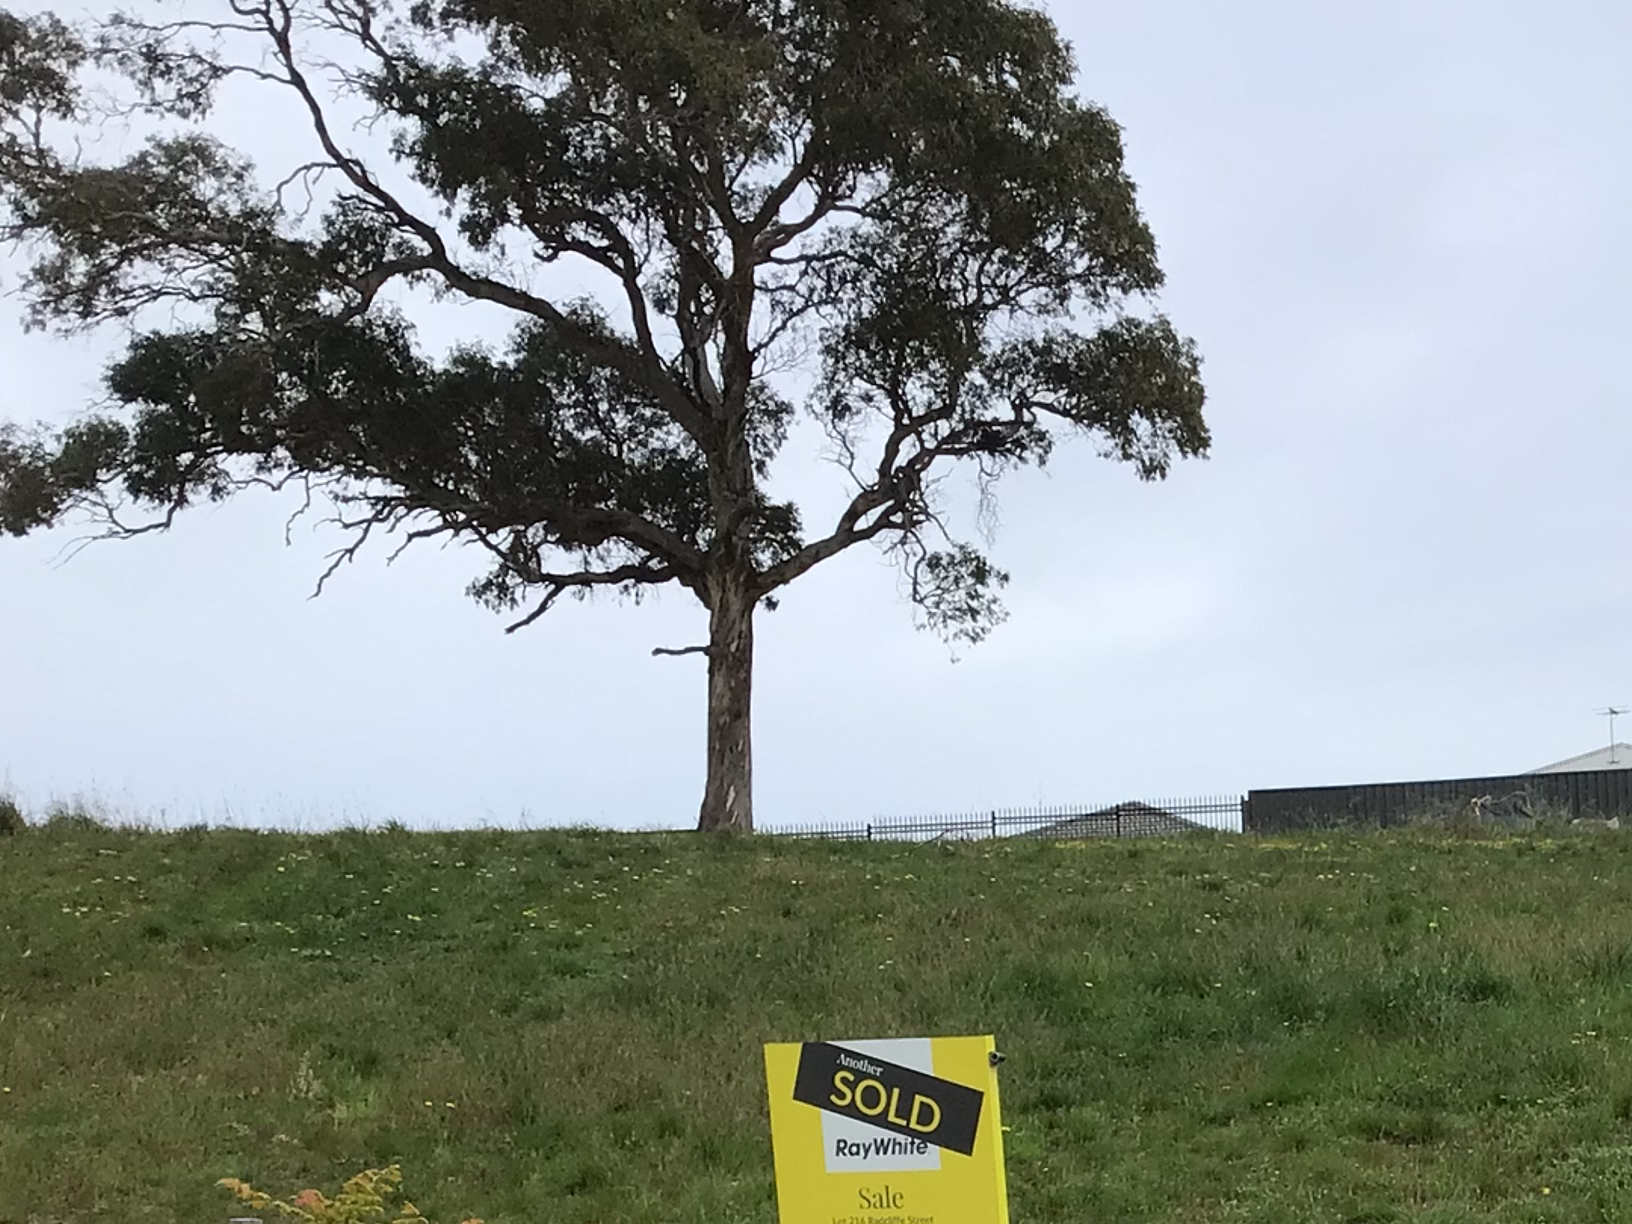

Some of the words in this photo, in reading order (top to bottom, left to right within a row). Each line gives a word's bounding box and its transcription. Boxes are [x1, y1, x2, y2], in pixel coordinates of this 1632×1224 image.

[836, 1053, 884, 1077] Another
[829, 1070, 942, 1133] SOLD
[858, 1185, 904, 1210] Sale
